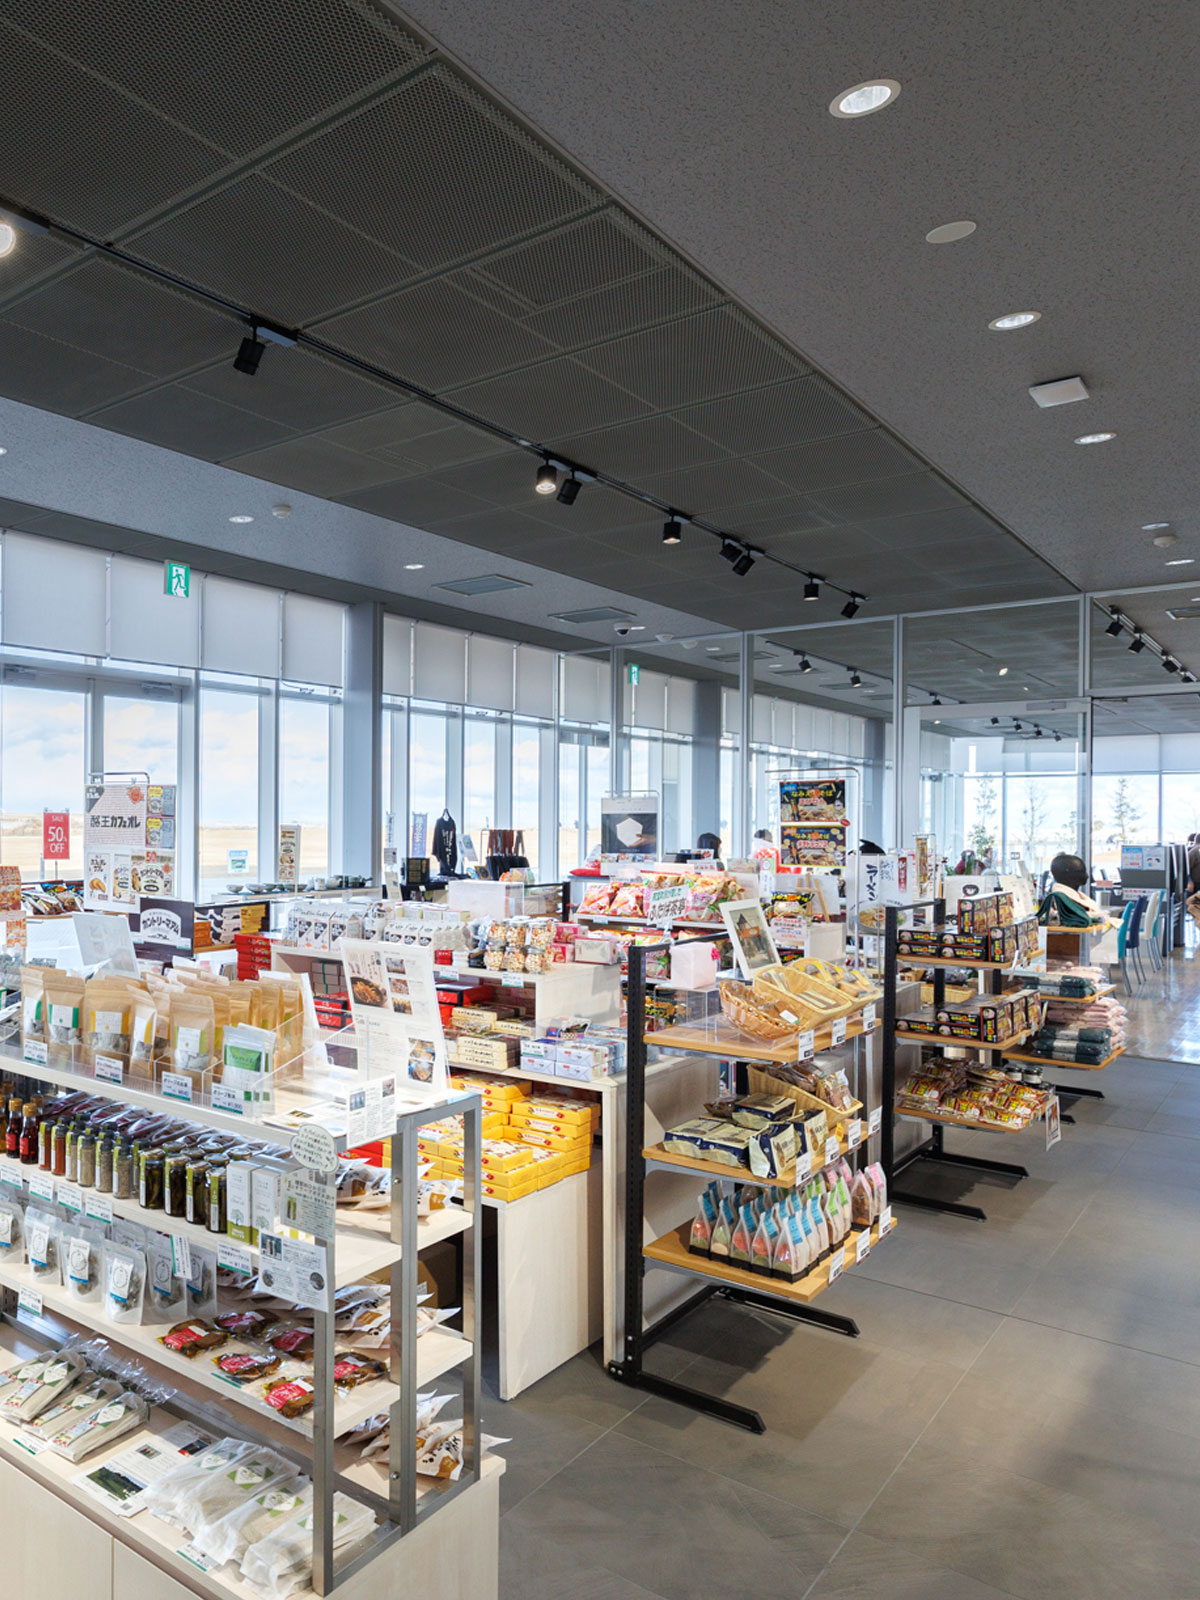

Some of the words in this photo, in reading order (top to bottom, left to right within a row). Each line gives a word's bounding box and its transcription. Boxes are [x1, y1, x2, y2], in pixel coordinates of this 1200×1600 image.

[50, 843, 65, 853] OFF
[866, 864, 878, 901] ラーメン
[141, 916, 180, 935] カントリーマアム
